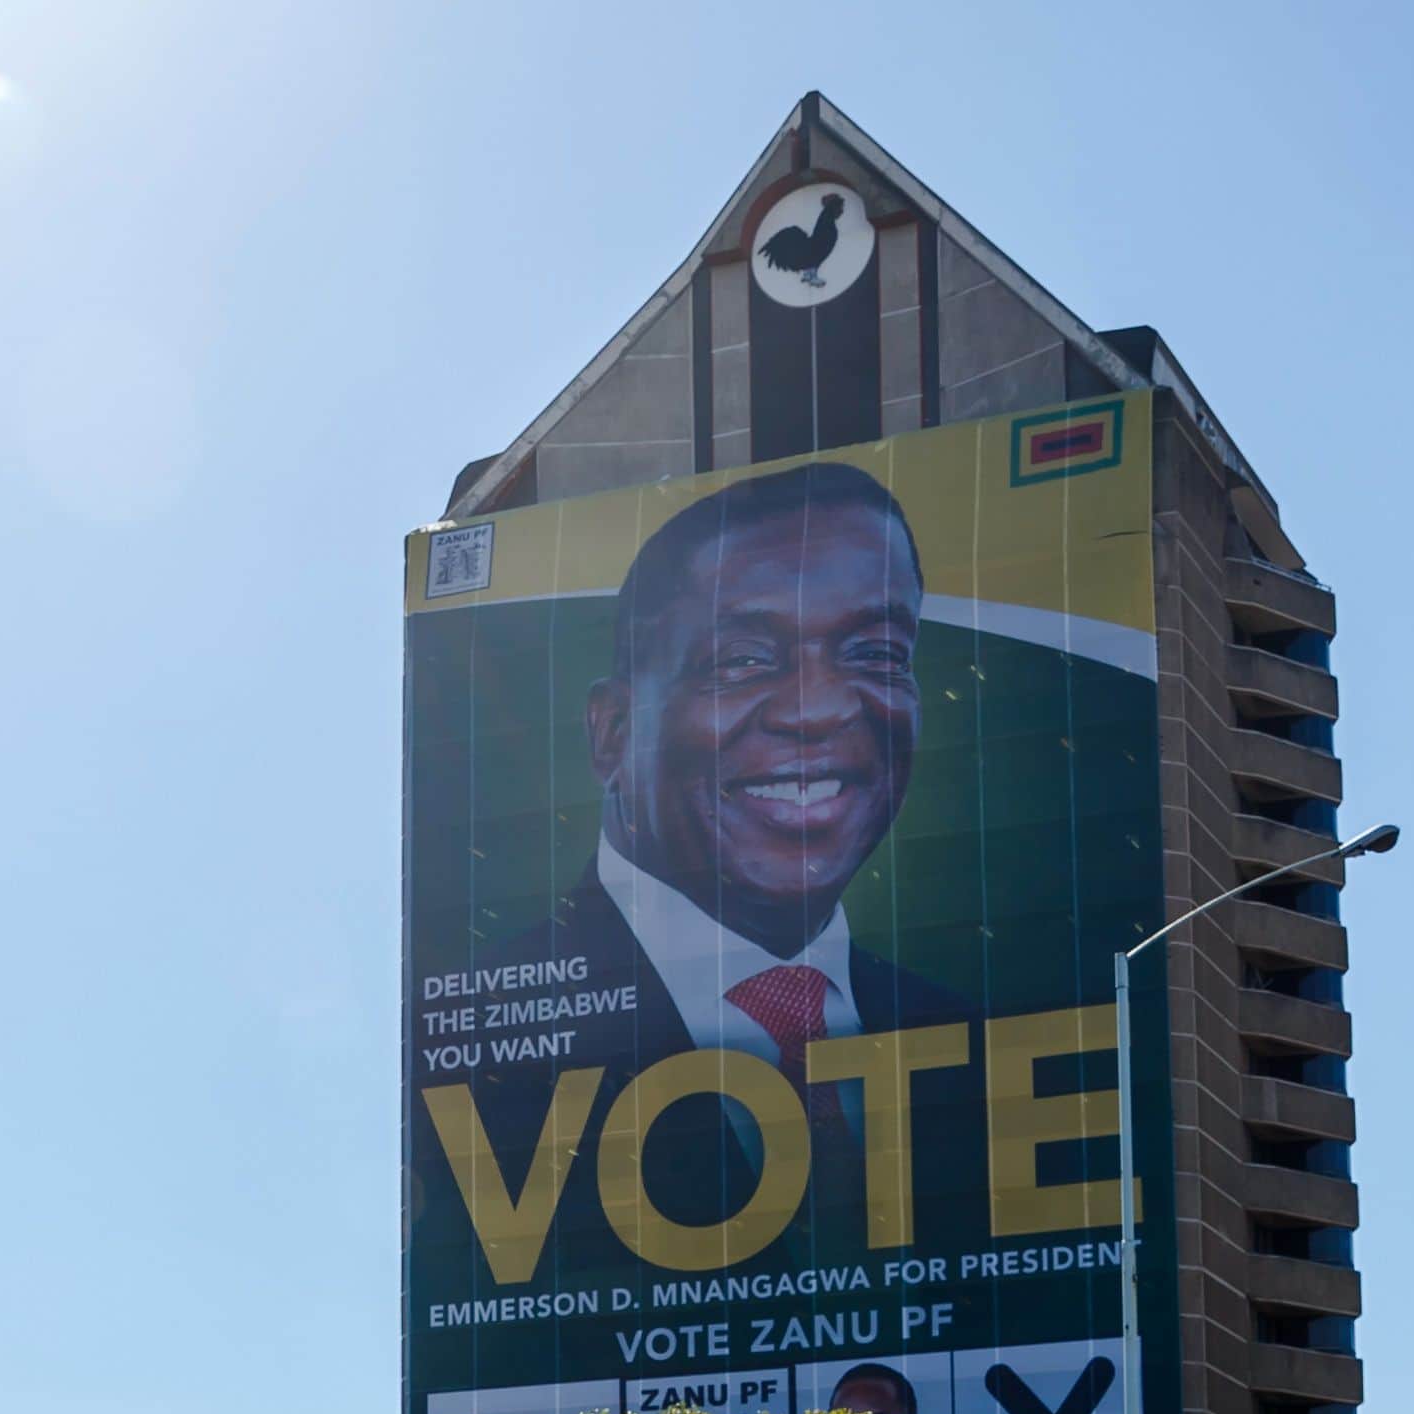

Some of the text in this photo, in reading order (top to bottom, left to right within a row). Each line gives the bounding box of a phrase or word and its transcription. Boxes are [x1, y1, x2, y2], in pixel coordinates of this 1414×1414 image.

[437, 528, 488, 546] ZANU PF
[423, 956, 588, 1000] DELIVERING
[423, 985, 638, 1036] THE ZIMBABWE
[423, 1031, 576, 1073] YOU WANT
[421, 1003, 1144, 1285] VOTE
[429, 1290, 599, 1328] EMMERSON
[611, 1288, 639, 1311] D.
[653, 1267, 870, 1308] MNANGAGWA
[884, 1258, 947, 1287] FOR
[616, 1303, 955, 1364] VOTE ZANU PF
[640, 1380, 778, 1411] ZANU PF
